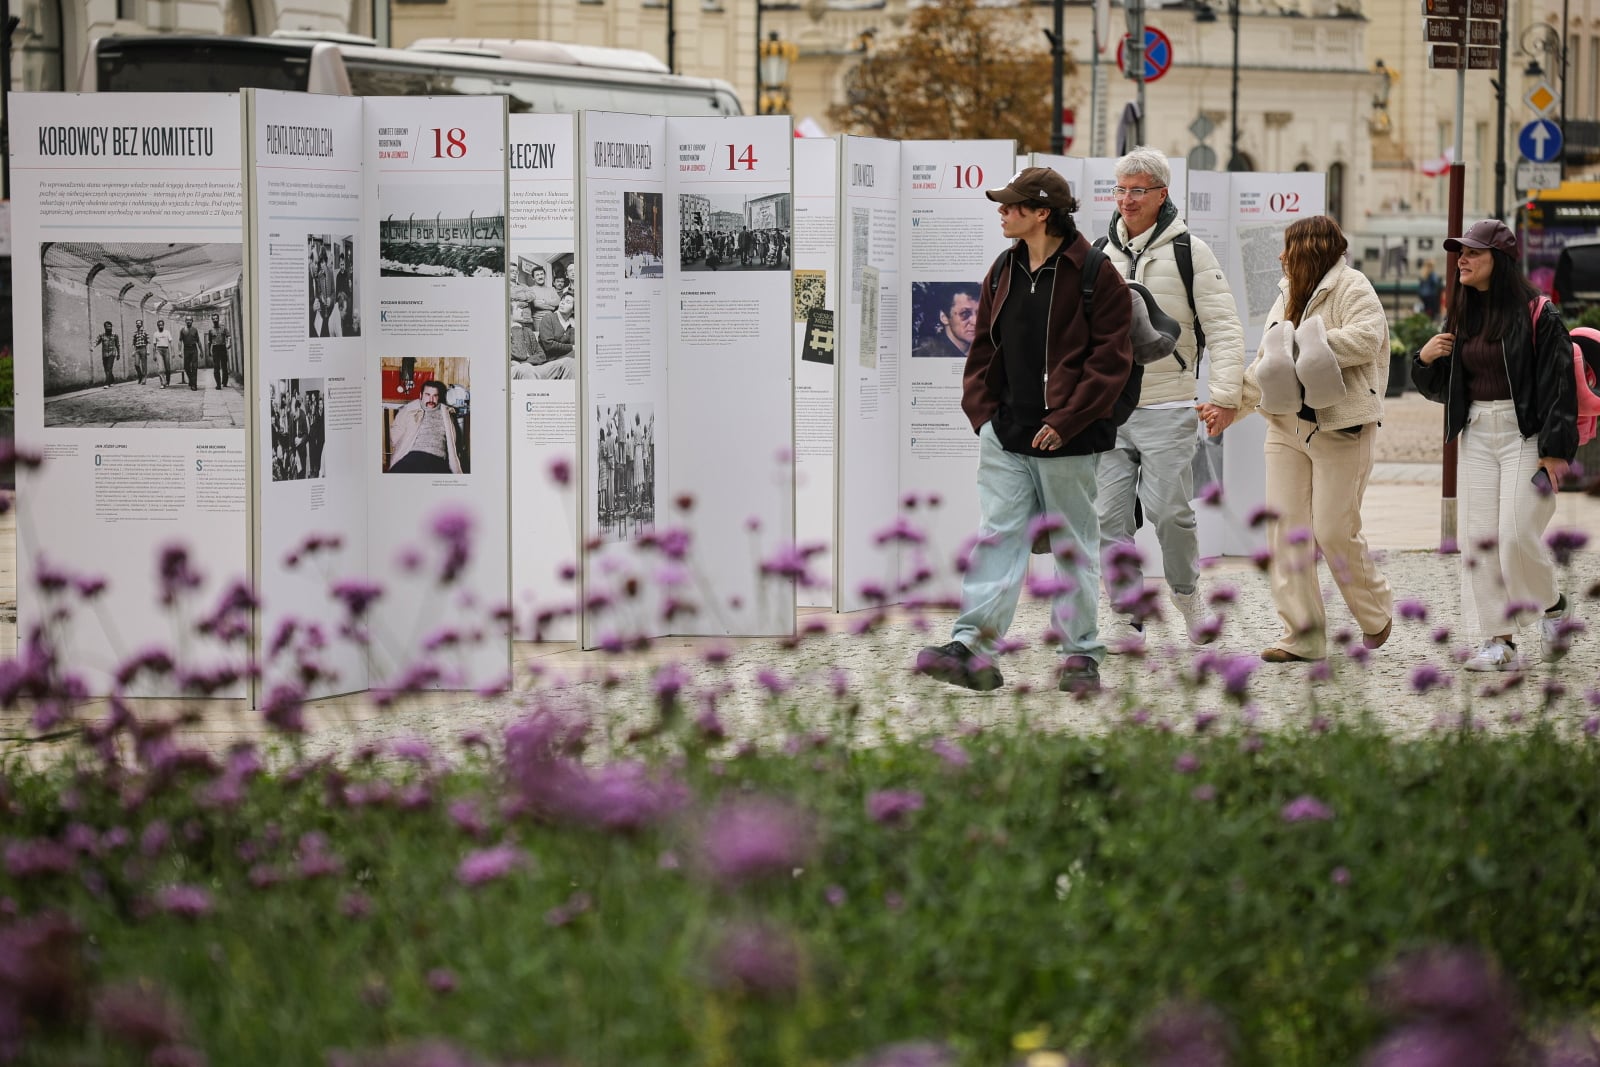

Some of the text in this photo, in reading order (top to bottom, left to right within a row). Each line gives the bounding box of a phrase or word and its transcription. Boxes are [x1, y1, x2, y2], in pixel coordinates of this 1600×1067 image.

[39, 126, 214, 156] KOROWCY BEZ KOMITETU
[266, 124, 289, 155] PUENTA
[430, 127, 467, 158] 18
[724, 144, 758, 171] 14
[952, 164, 984, 190] 10
[1269, 192, 1300, 213] 02
